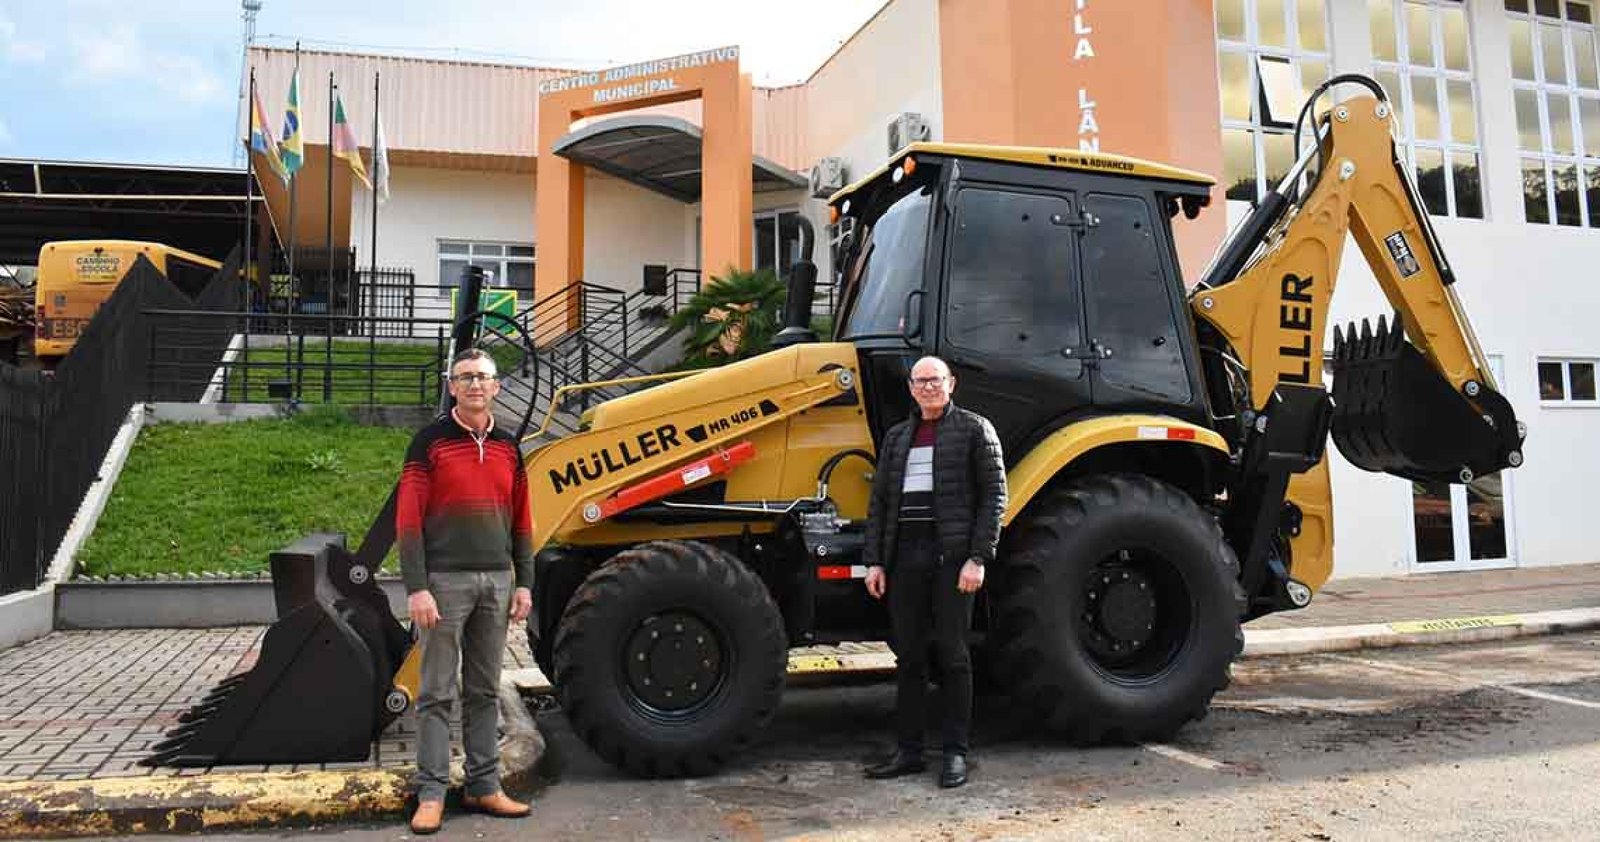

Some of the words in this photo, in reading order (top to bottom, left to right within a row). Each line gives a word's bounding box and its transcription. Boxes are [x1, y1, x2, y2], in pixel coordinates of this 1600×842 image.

[539, 71, 598, 95] CENTRO
[605, 45, 739, 82] ADMINISTRATIVO
[593, 78, 676, 103] MUNICIPAL
[1278, 273, 1314, 384] LLER
[548, 424, 681, 494] MÜLLER
[708, 417, 730, 435] MR
[730, 408, 758, 425] 406
